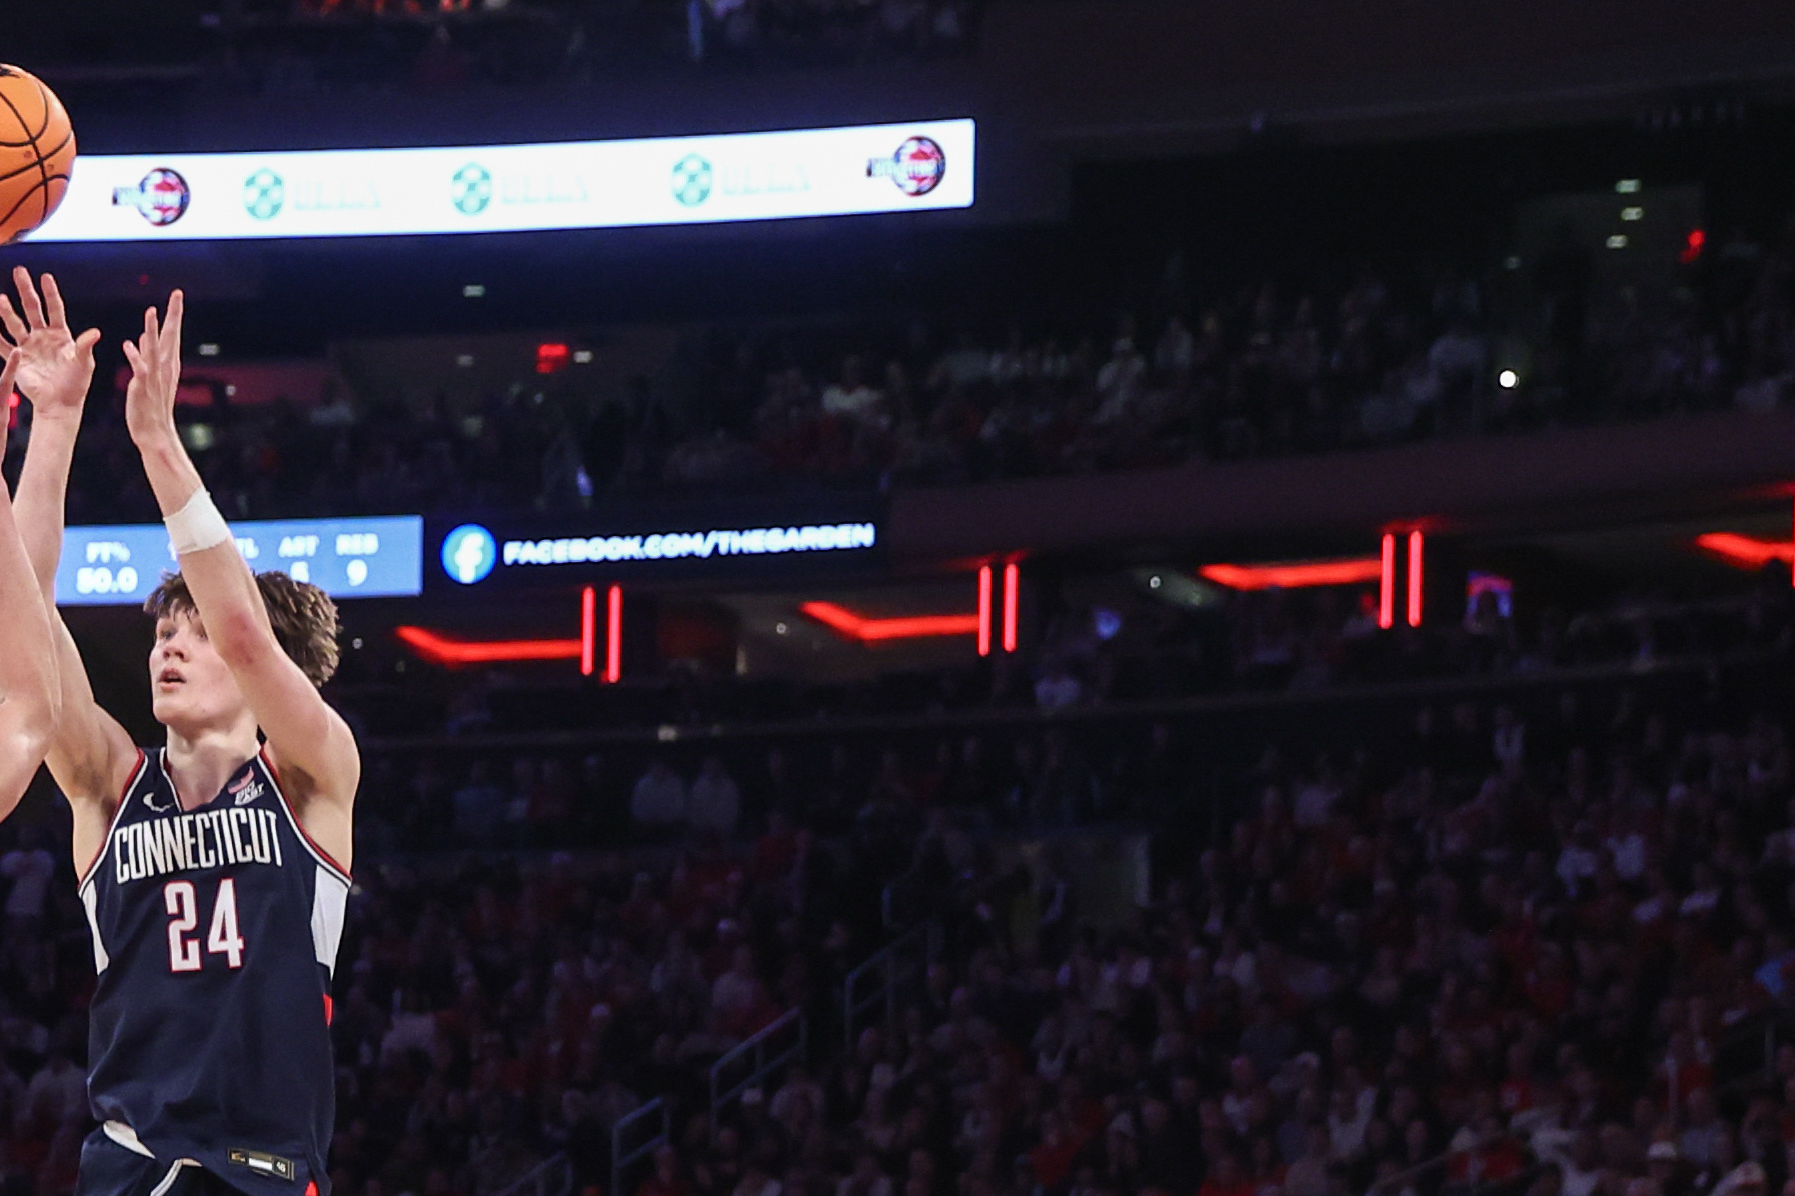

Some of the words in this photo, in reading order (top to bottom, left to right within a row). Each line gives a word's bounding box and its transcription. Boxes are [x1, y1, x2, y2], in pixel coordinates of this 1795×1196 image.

[503, 522, 876, 566] FACEBOOK.COM/THEGARDEN
[76, 566, 139, 594] 50.0
[346, 558, 368, 587] 9
[114, 807, 283, 885] CONNECTICUT
[163, 877, 246, 973] 24
